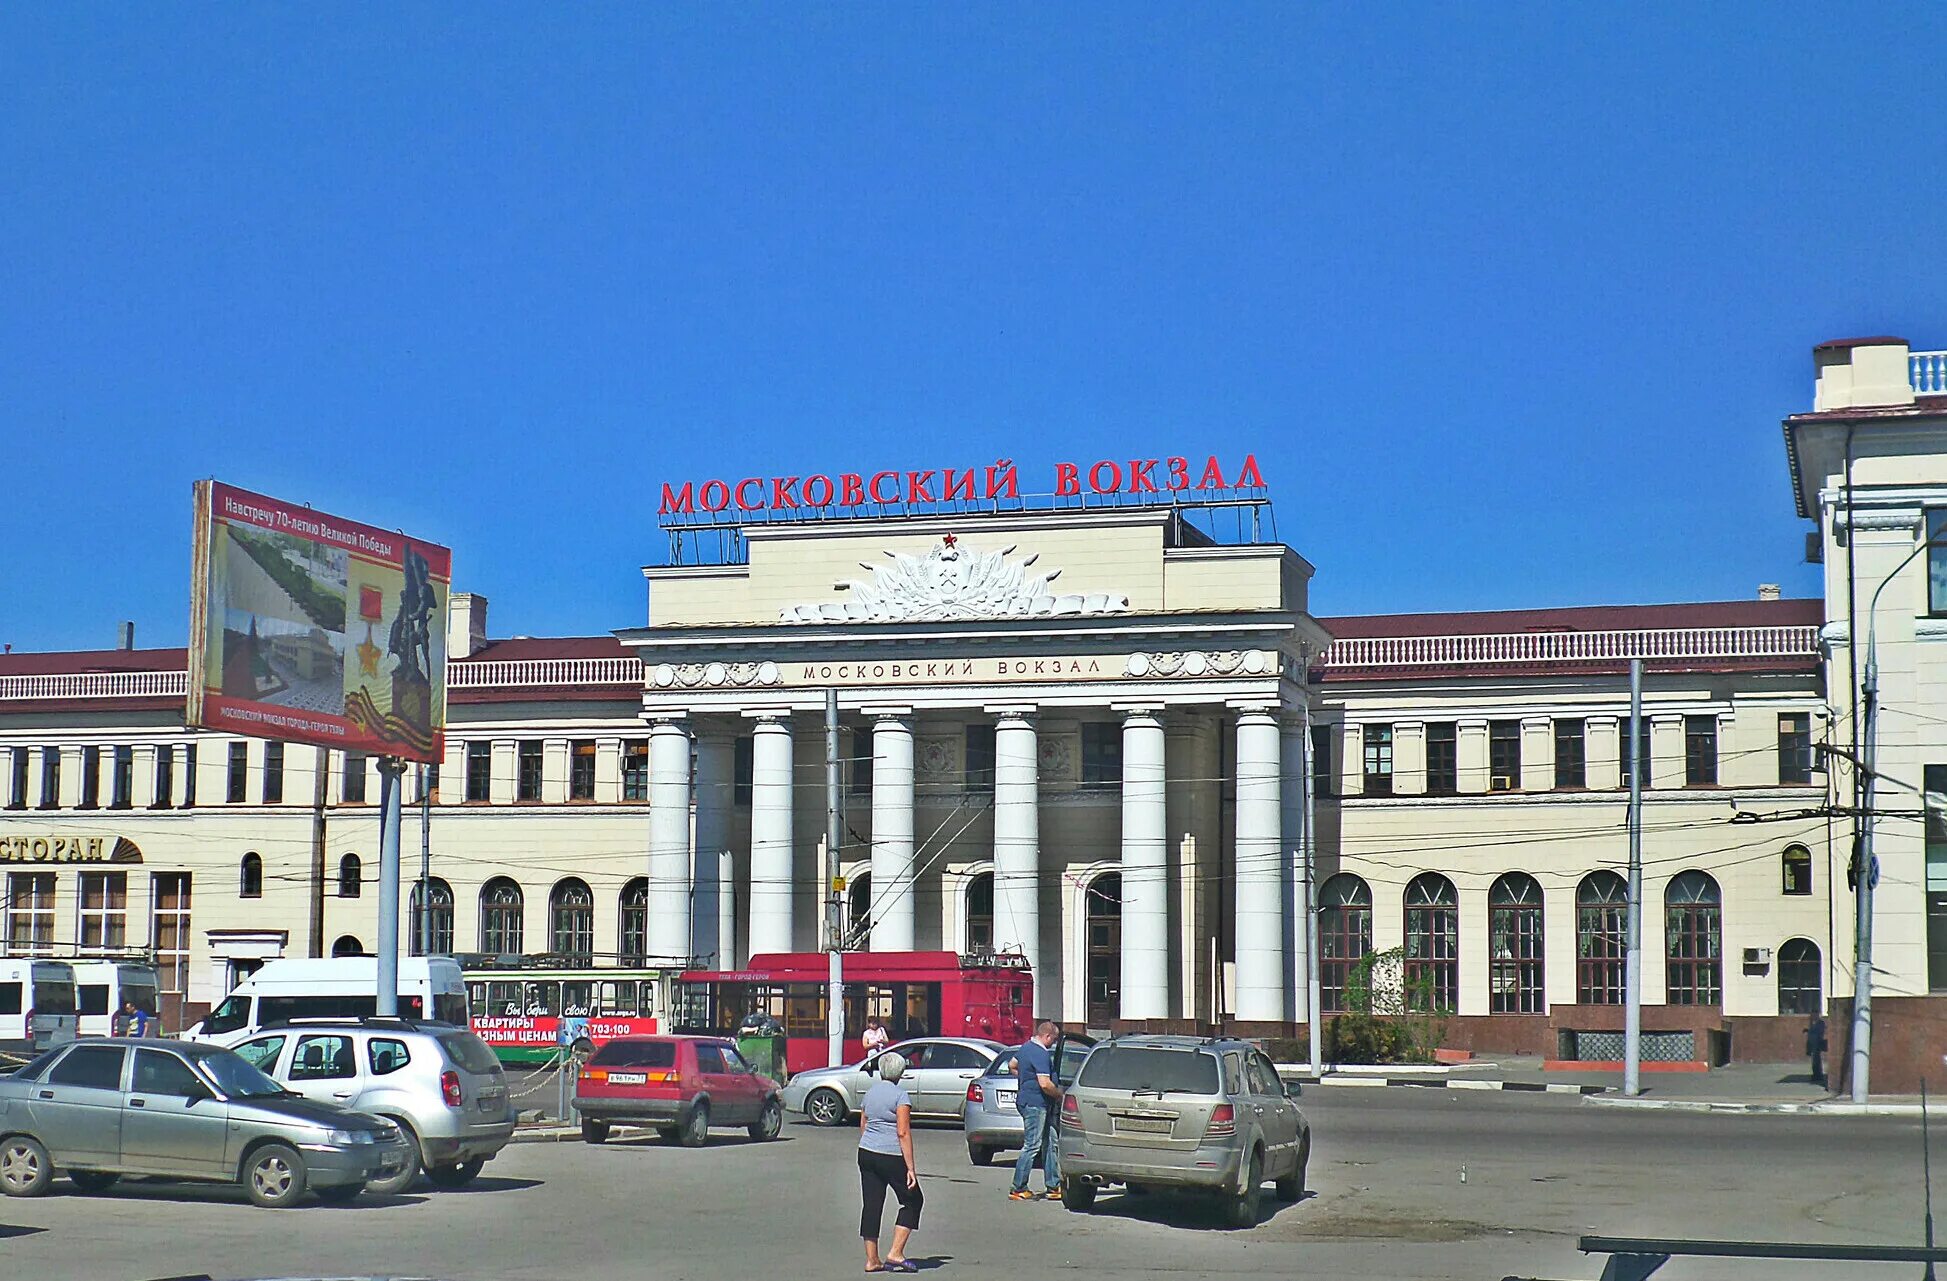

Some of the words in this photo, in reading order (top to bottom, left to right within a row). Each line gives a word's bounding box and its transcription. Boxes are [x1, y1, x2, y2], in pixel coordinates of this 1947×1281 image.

[657, 458, 1021, 514] МОСКОВСКИЙ
[1055, 454, 1267, 496] ВОКЗАЛ
[225, 496, 274, 527] Навстречу
[276, 511, 319, 537] 70-летию
[321, 523, 358, 546] Великой
[359, 533, 392, 556] Победы
[803, 660, 973, 680] МОСКОВСКИЙ
[998, 660, 1100, 675] ВОКЗАЛ
[473, 1017, 534, 1029] КВАРТИРЫ
[518, 1030, 557, 1044] ЦЕНАМ
